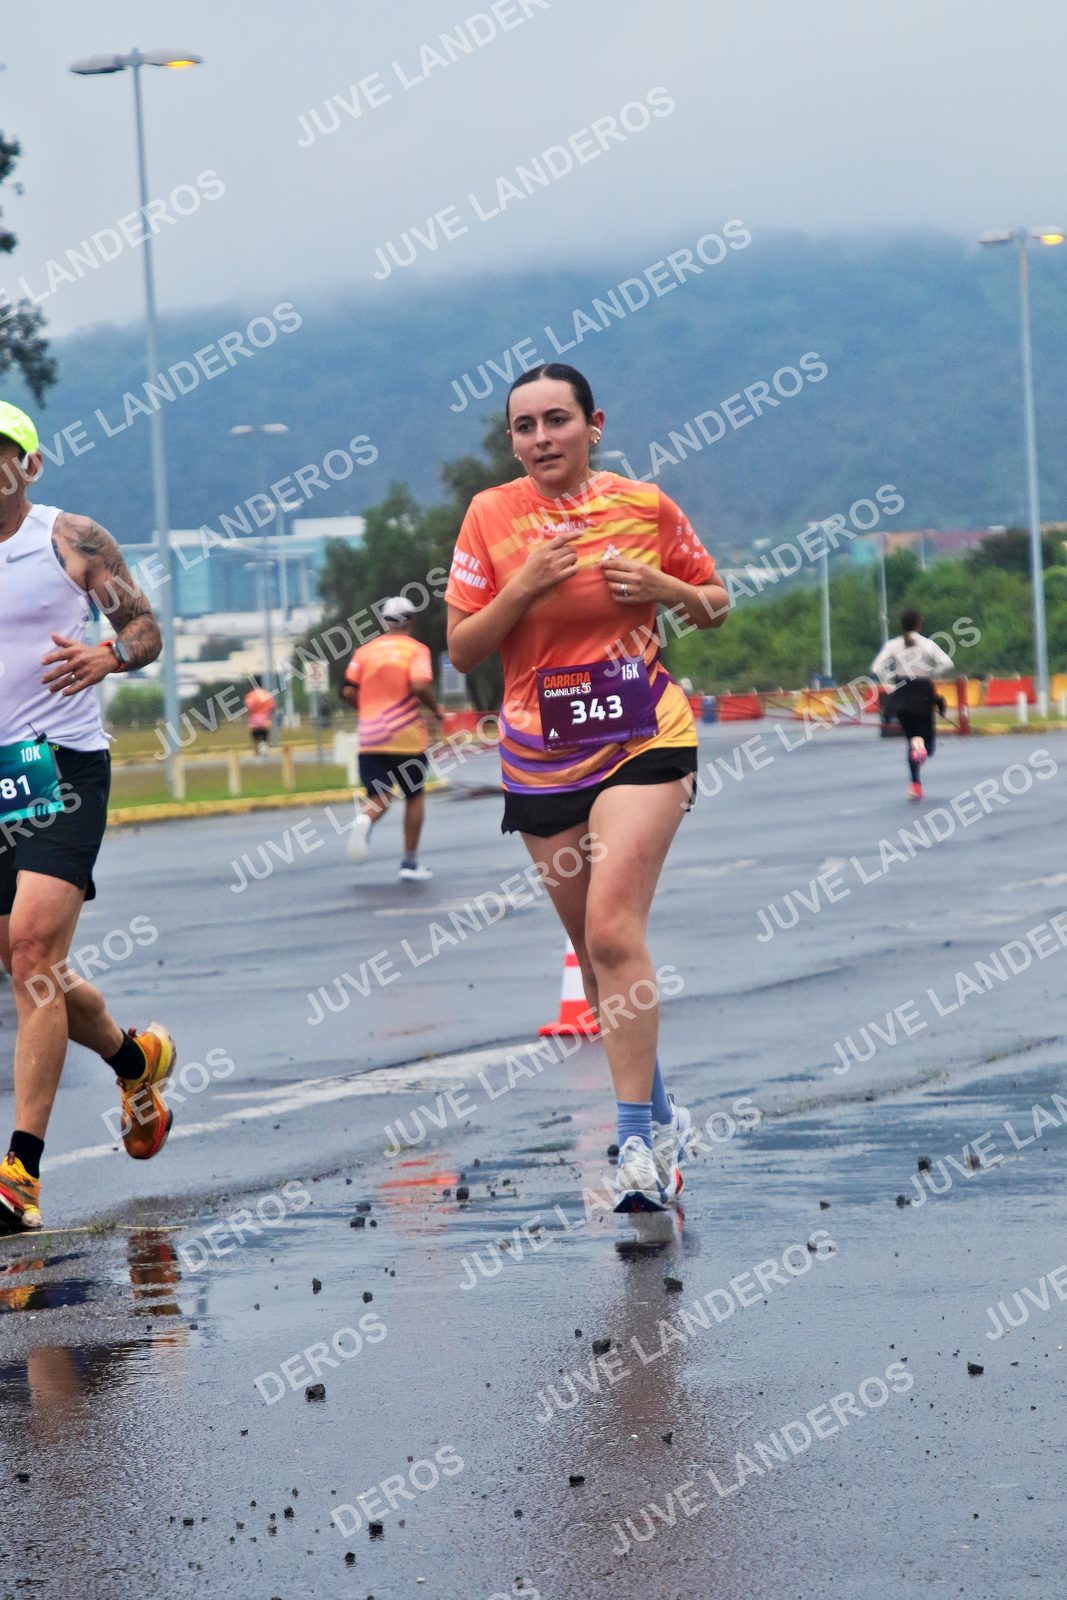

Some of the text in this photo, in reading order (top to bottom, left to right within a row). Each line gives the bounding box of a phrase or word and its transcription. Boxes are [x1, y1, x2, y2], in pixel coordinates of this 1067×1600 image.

[543, 671, 591, 689] CARRERA
[621, 663, 640, 680] 15K
[570, 695, 623, 724] 343
[20, 744, 41, 763] 10K
[0, 774, 31, 799] 81
